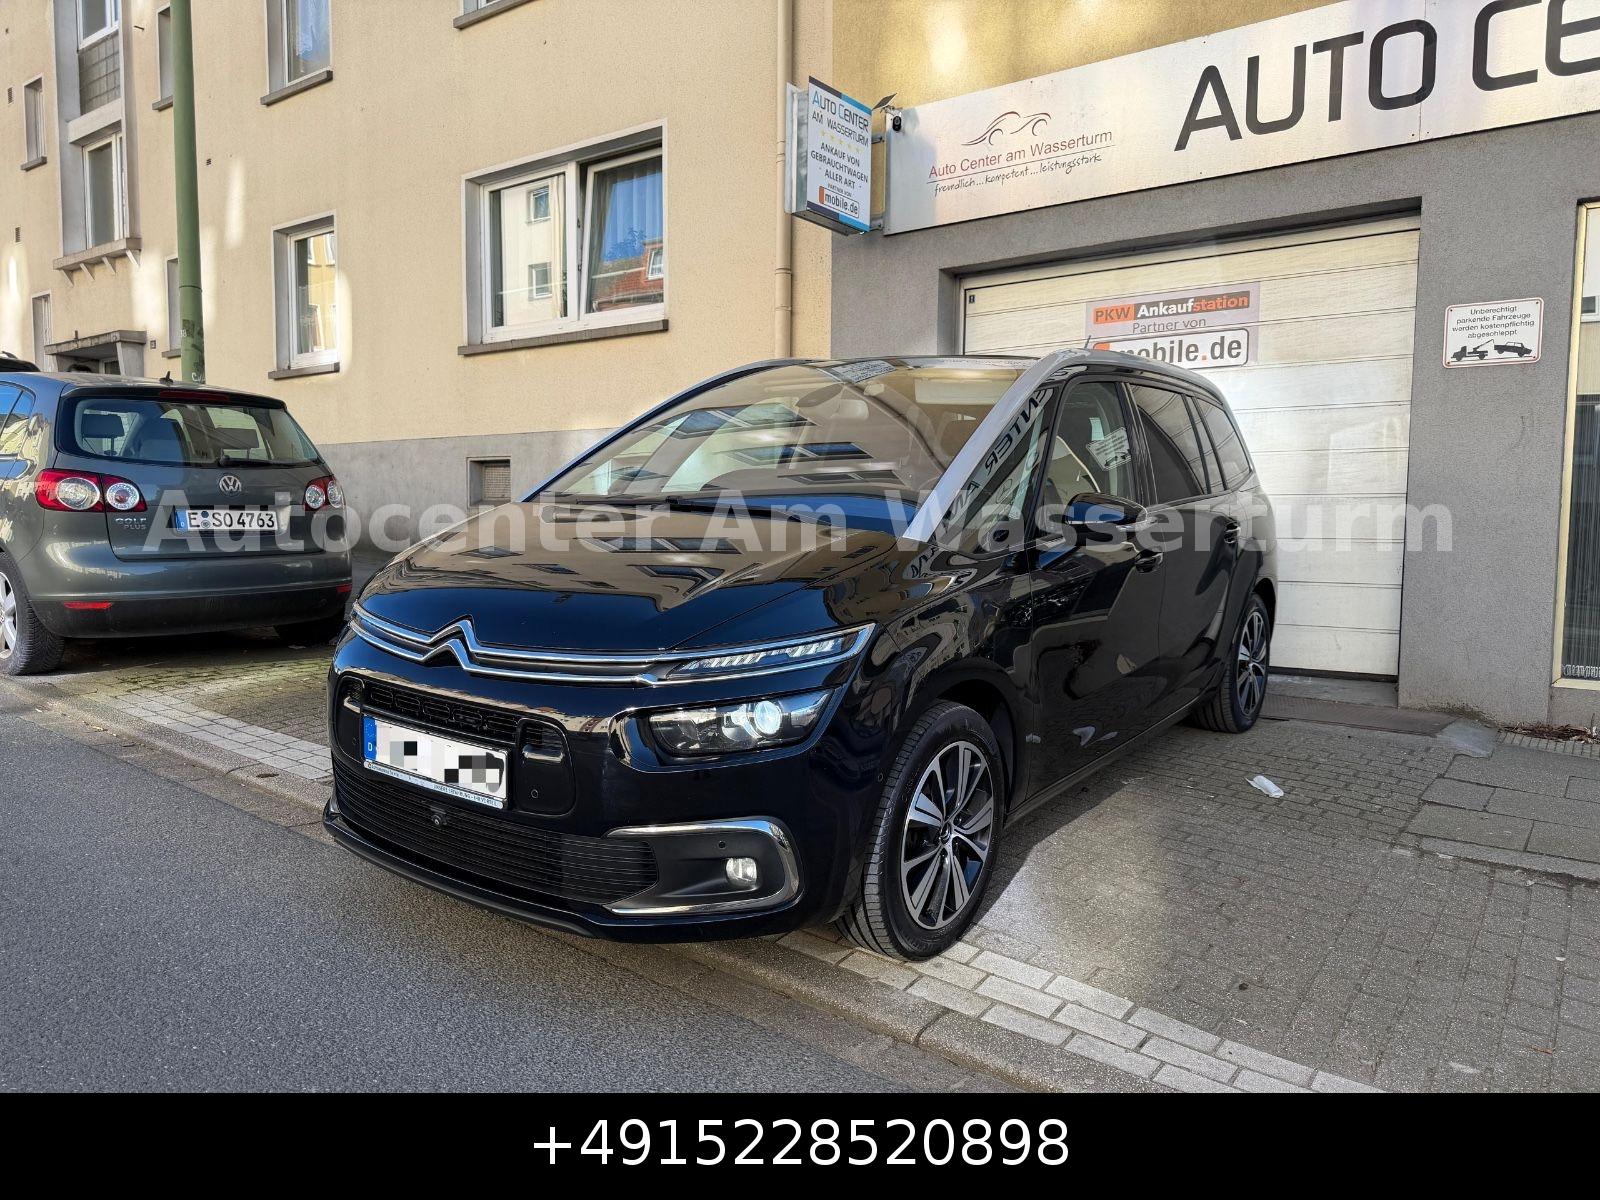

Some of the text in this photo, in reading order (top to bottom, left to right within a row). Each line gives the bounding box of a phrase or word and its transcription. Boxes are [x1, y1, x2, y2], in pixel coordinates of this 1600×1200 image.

[1174, 19, 1437, 152] AUTO
[812, 91, 868, 132] AUTO CENTER
[812, 111, 868, 147] AM WASSERTURM
[811, 150, 868, 183] GEBRAUCHTWAGEN
[820, 142, 860, 167] ANKAUF VON
[929, 132, 1112, 178] Auto Center am Wasserturm
[824, 169, 855, 190] ALLER ART
[825, 193, 858, 214] mobile.de
[1095, 295, 1248, 322] PKW Ankaufstation
[1470, 305, 1517, 315] Unberechtigt
[1492, 313, 1531, 321] Fahrzeuge
[1133, 319, 1206, 334] Partner von
[1120, 336, 1242, 364] bile.de
[188, 512, 201, 528] E
[212, 512, 234, 529] SO
[237, 512, 276, 529] 4763
